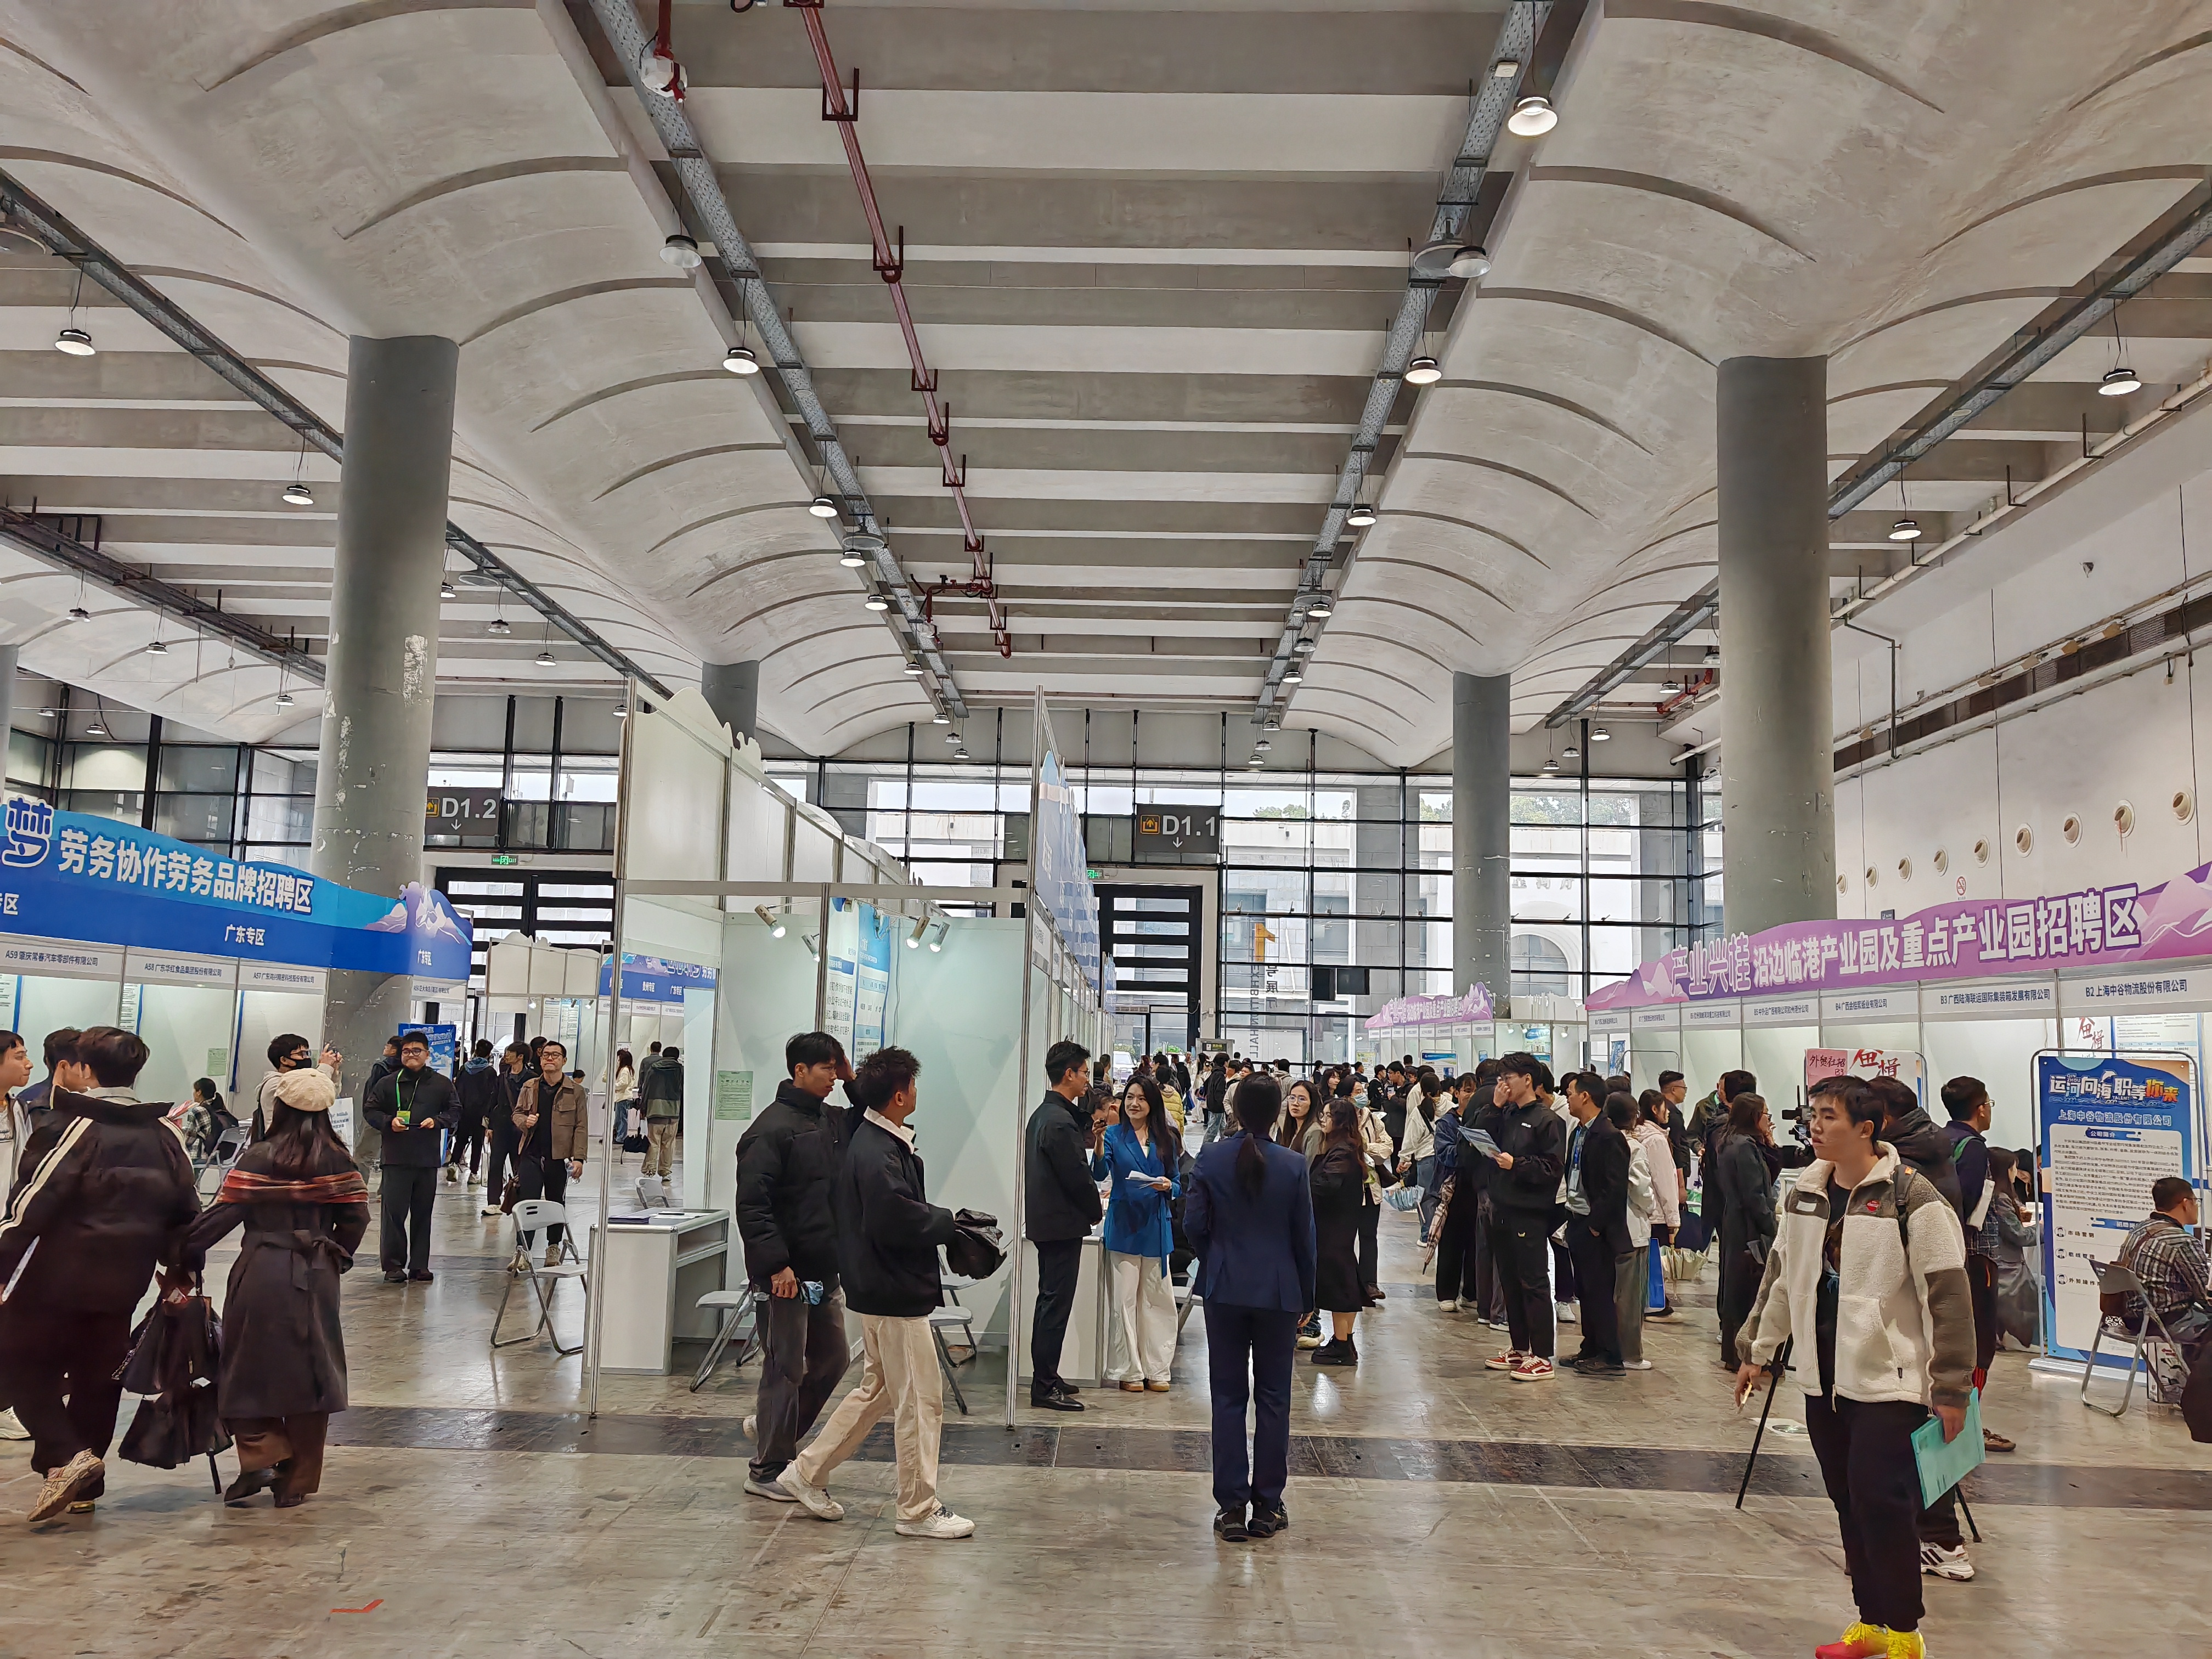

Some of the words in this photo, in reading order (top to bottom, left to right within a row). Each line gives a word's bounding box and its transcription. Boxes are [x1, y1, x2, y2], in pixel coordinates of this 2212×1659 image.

[441, 797, 496, 819] D1.2
[1162, 815, 1215, 836] D1.1
[58, 828, 314, 913] 劳务协作劳务品牌招聘区
[0, 891, 19, 915] 区
[224, 924, 266, 946] 广东专区
[1670, 932, 1751, 997] 产业兴桂
[1753, 887, 2140, 988] 沿边临港产业园及重点产业园招聘区
[5, 950, 18, 959] A59
[1940, 995, 1948, 1005] B3
[1948, 989, 2051, 1005] 广西陆海联运国际集装箱发展有限公司
[2086, 985, 2095, 997] B2
[2096, 979, 2188, 997] 上海中谷物流股份有限公司
[1809, 1054, 1846, 1068] 外贸社招
[2058, 1109, 2172, 1126] 上海中谷物流股份有限公司
